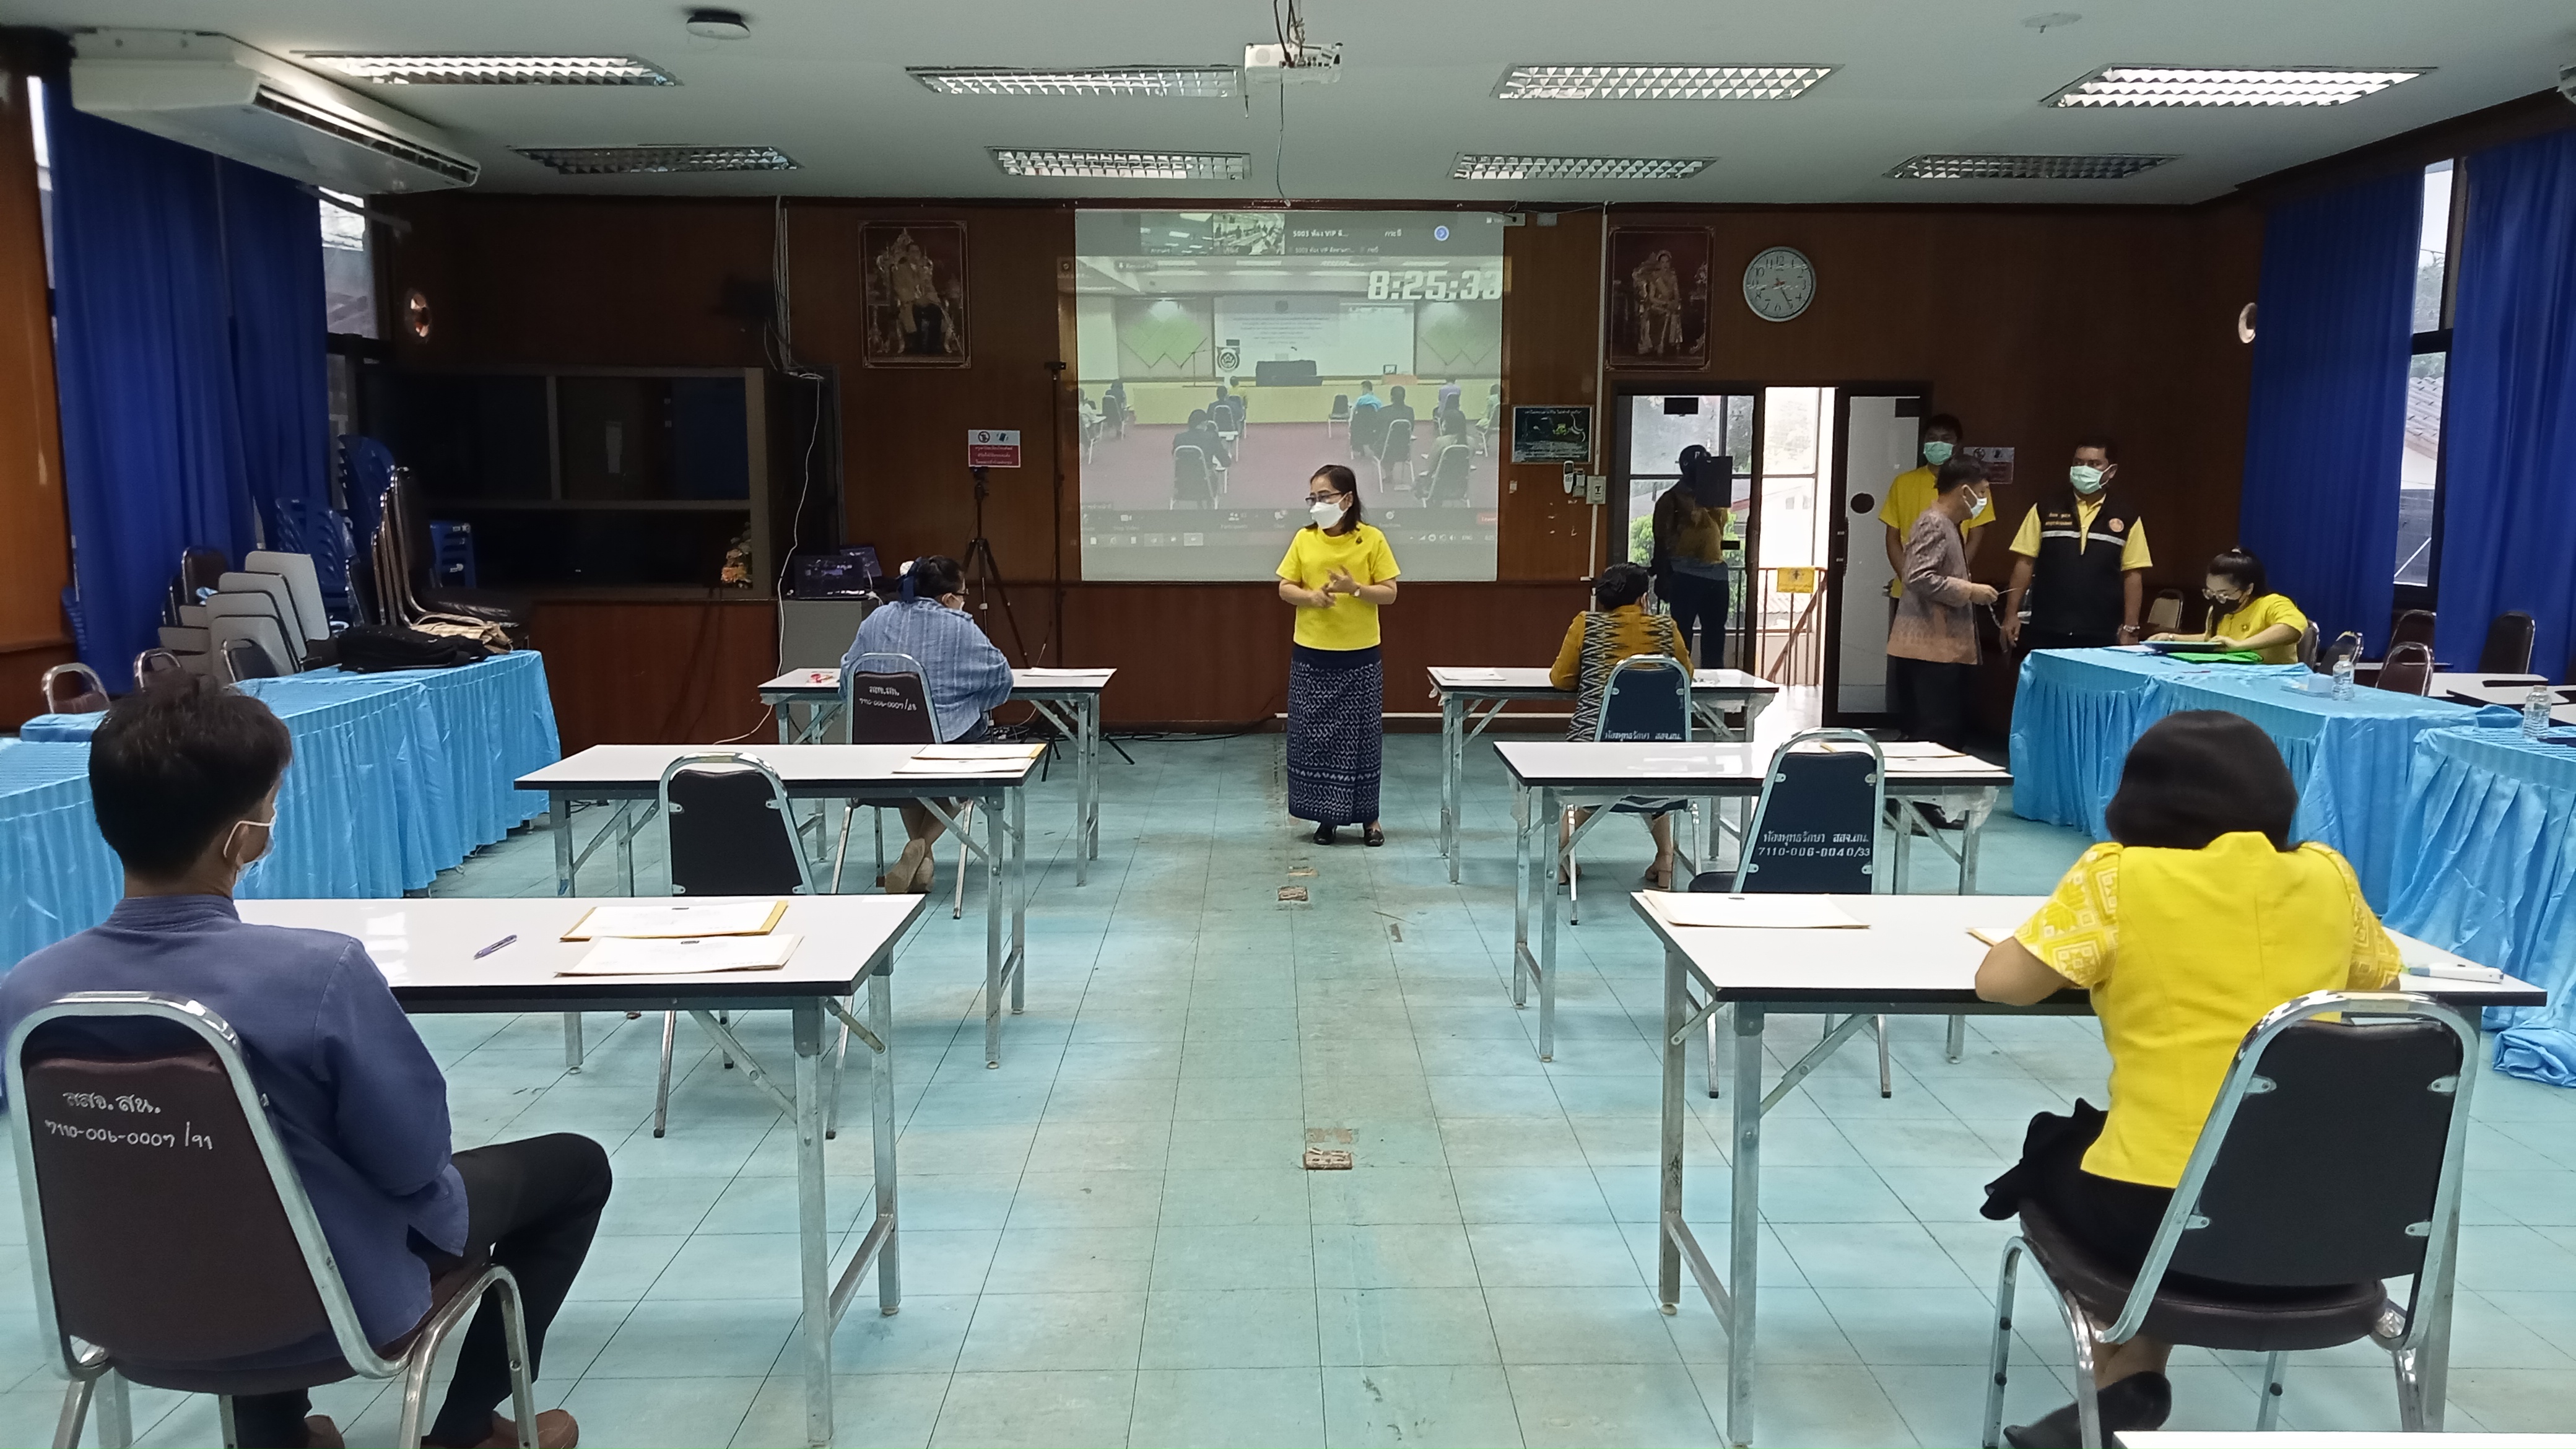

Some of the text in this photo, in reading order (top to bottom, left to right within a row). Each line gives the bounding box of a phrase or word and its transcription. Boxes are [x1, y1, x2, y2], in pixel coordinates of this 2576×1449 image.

[1764, 830, 1825, 846] ห้องพุทธรักษา
[1758, 846, 1870, 858] 7110-006-0040/33
